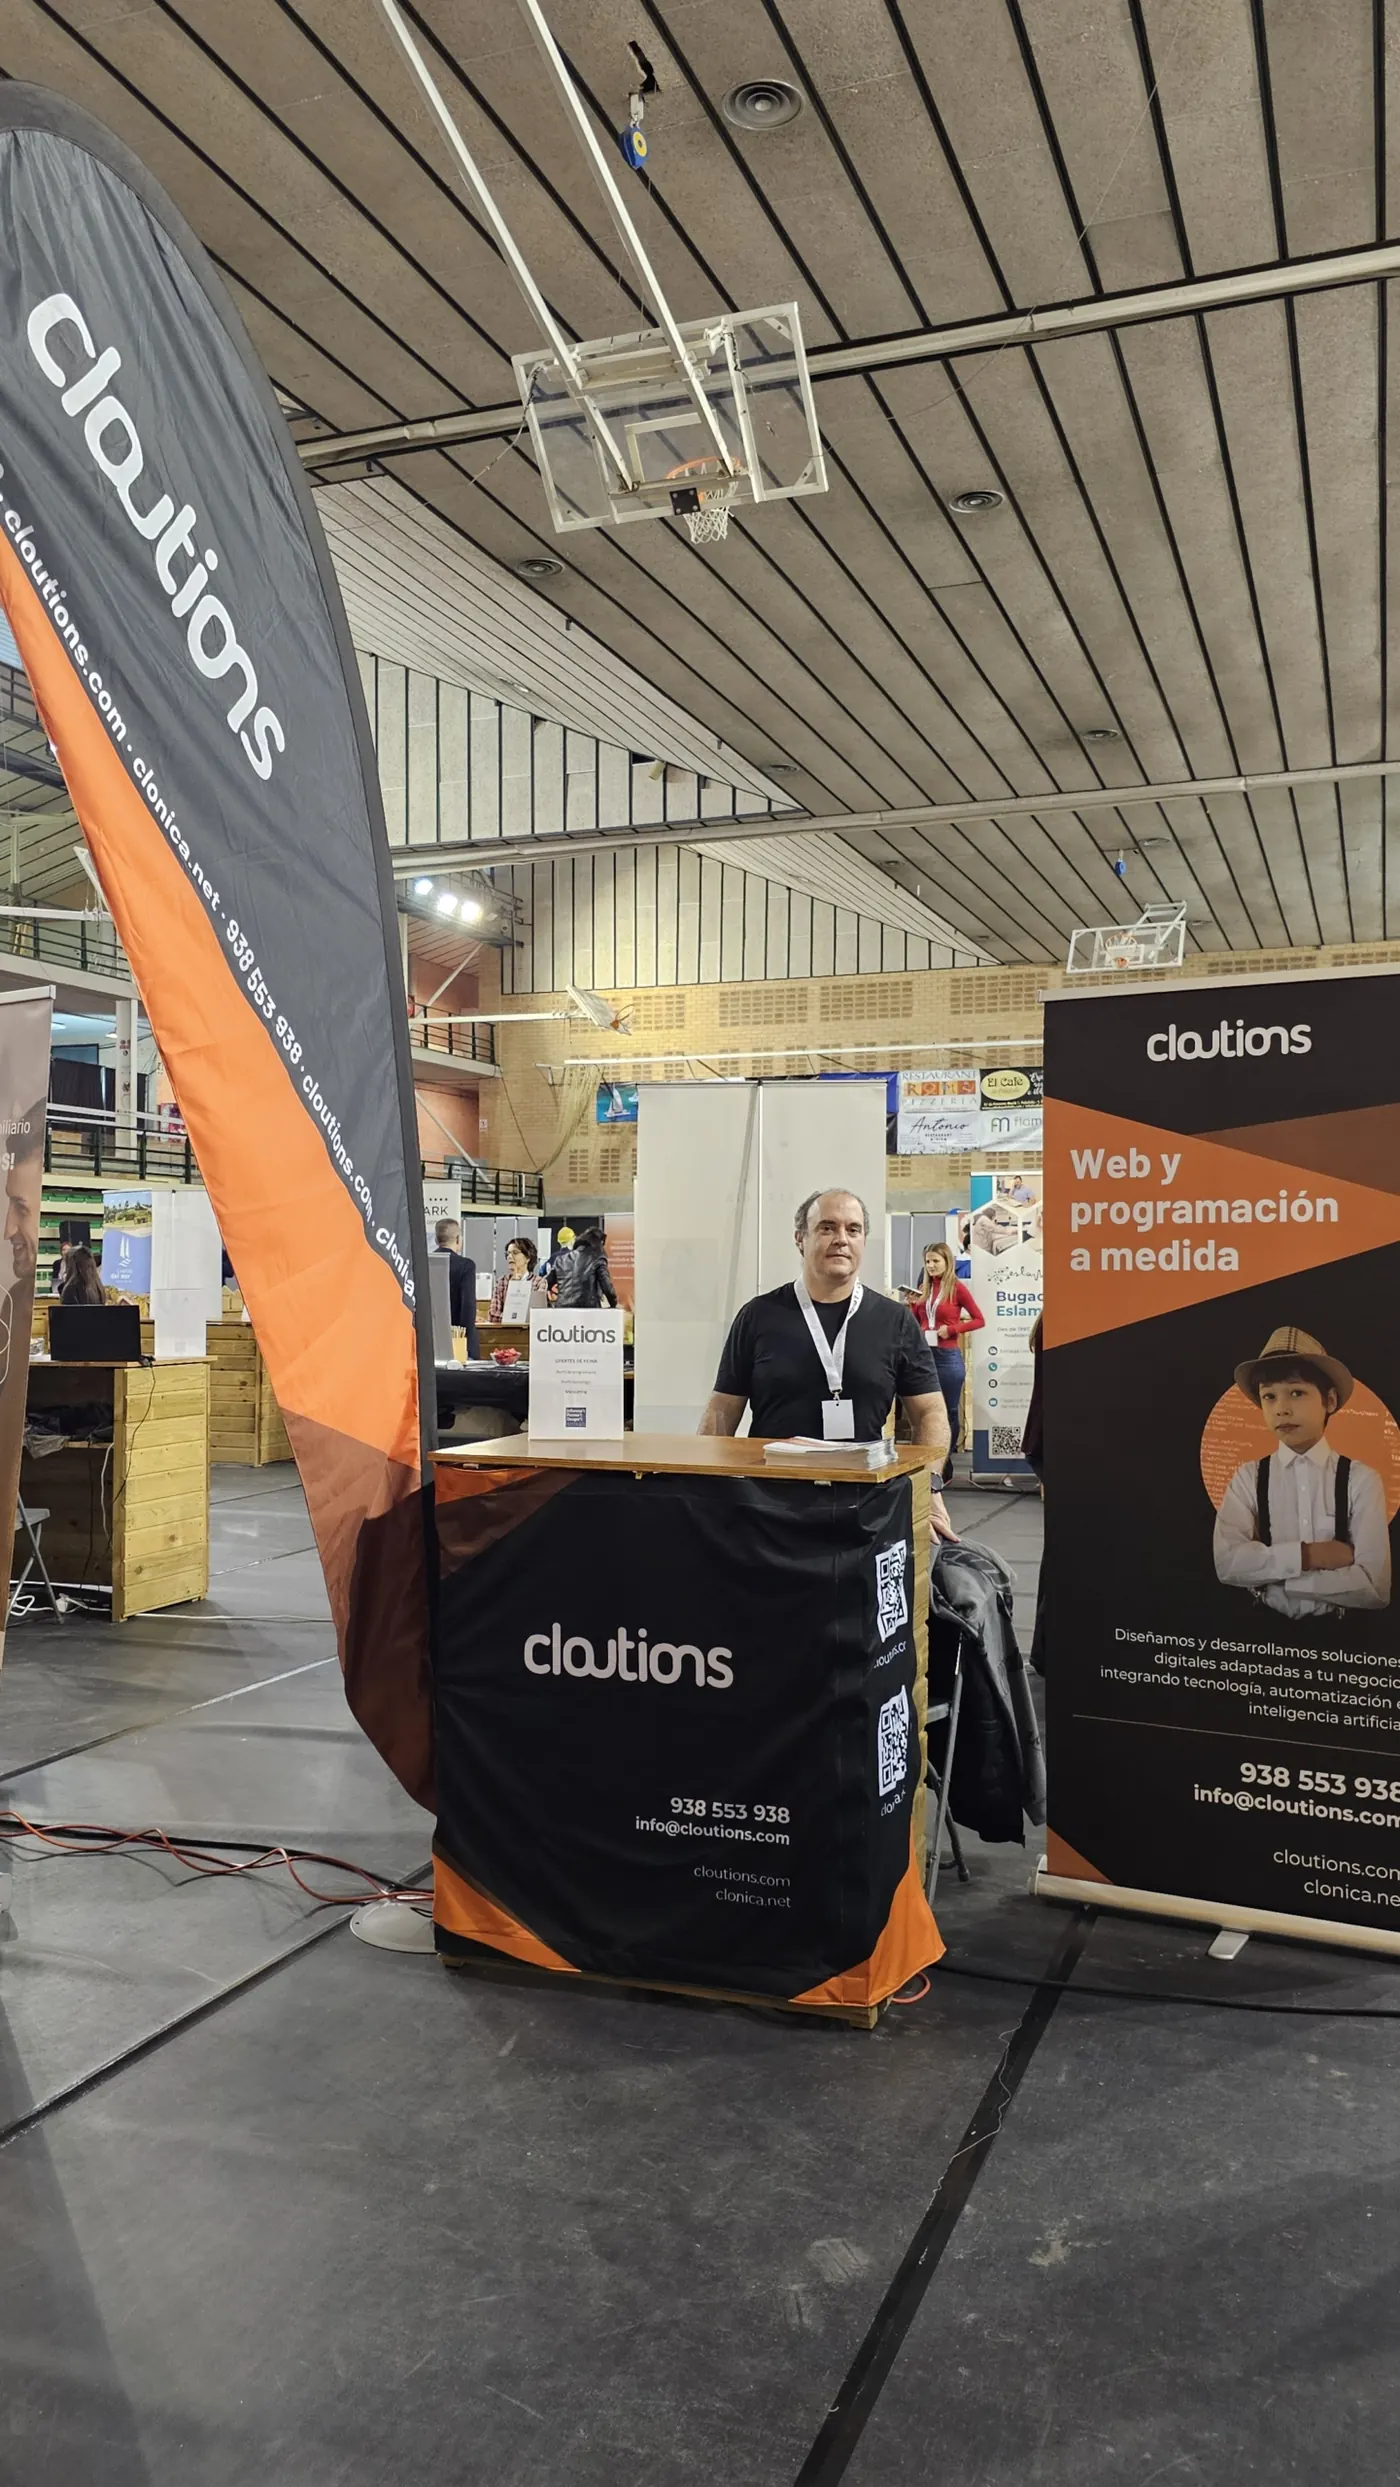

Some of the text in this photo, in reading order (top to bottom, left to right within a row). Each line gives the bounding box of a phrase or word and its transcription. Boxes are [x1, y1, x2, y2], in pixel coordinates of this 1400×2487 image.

[27, 293, 285, 781] cloutions
[5, 510, 127, 742] cloutions.com
[133, 756, 220, 911] clonica.net
[227, 919, 254, 972] 938
[247, 966, 276, 1019] 553
[275, 1016, 302, 1064] 938
[302, 1075, 374, 1222] cloutions.com
[1147, 1019, 1312, 1062] cloutions
[902, 1071, 977, 1081] RESTAURANT
[987, 1078, 997, 1087] El
[1070, 1148, 1181, 1185] Web y
[1070, 1190, 1339, 1231] programación
[1070, 1240, 1239, 1271] a medida
[537, 1325, 616, 1343] cloutions
[523, 1622, 734, 1688] cloutions
[1115, 1628, 1400, 1669] Diseñamos y desarrollamos solucione
[1154, 1652, 1216, 1671] digitales
[1220, 1659, 1300, 1679] adaptadas
[1304, 1669, 1312, 1680] a
[1317, 1669, 1333, 1682] tu
[1100, 1665, 1180, 1686] integrando
[1184, 1676, 1266, 1698] tecnología,
[1269, 1687, 1392, 1709] automatización
[1248, 1701, 1339, 1724] inteligencia
[1240, 1762, 1400, 1803] 938 553 938
[670, 1796, 791, 1824] 938 553 938
[635, 1816, 791, 1846] info@cloutions.com
[693, 1864, 791, 1888] cloutions.com
[715, 1887, 791, 1909] clonica.net
